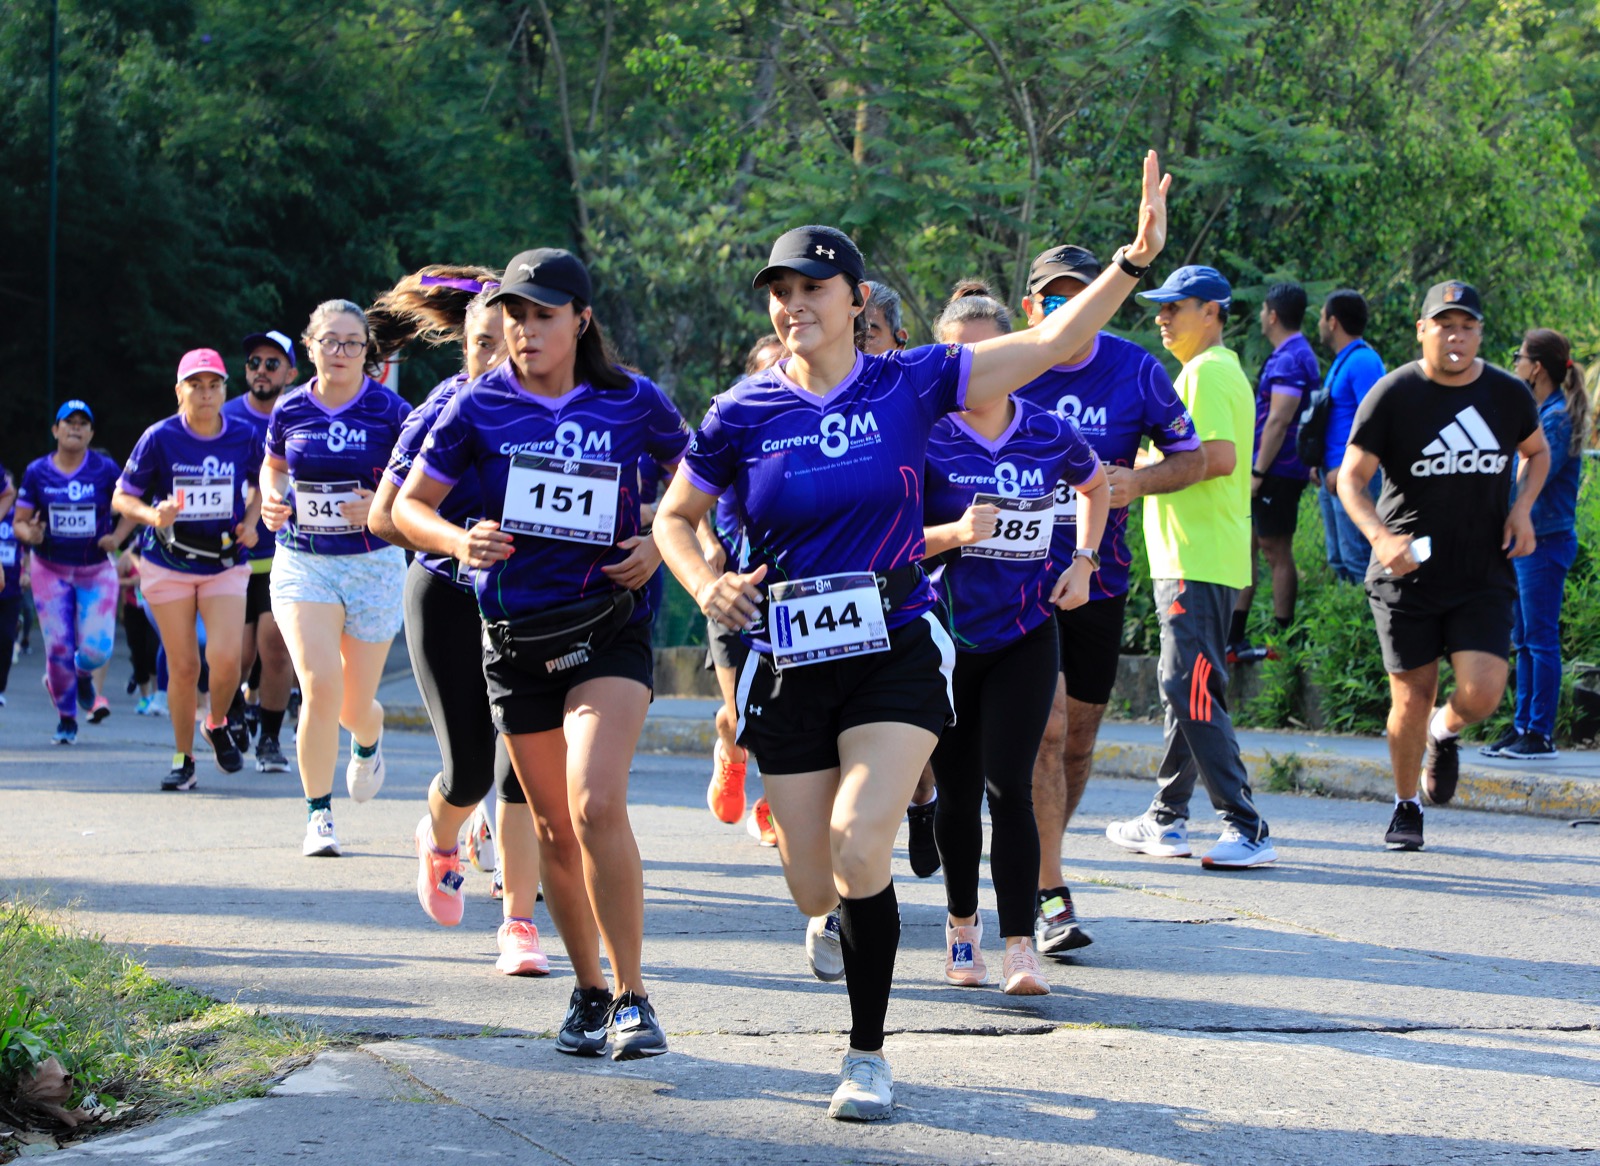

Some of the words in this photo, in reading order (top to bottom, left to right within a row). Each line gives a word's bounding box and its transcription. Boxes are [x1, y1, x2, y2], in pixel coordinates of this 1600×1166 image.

[500, 440, 555, 455] Carrera
[761, 434, 819, 453] Carrera
[1410, 447, 1509, 477] adidas
[948, 472, 997, 485] Carrera
[186, 491, 222, 507] 115
[529, 482, 594, 517] 151
[59, 515, 87, 528] 205
[791, 601, 863, 637] 144
[545, 648, 589, 673] PUMA
